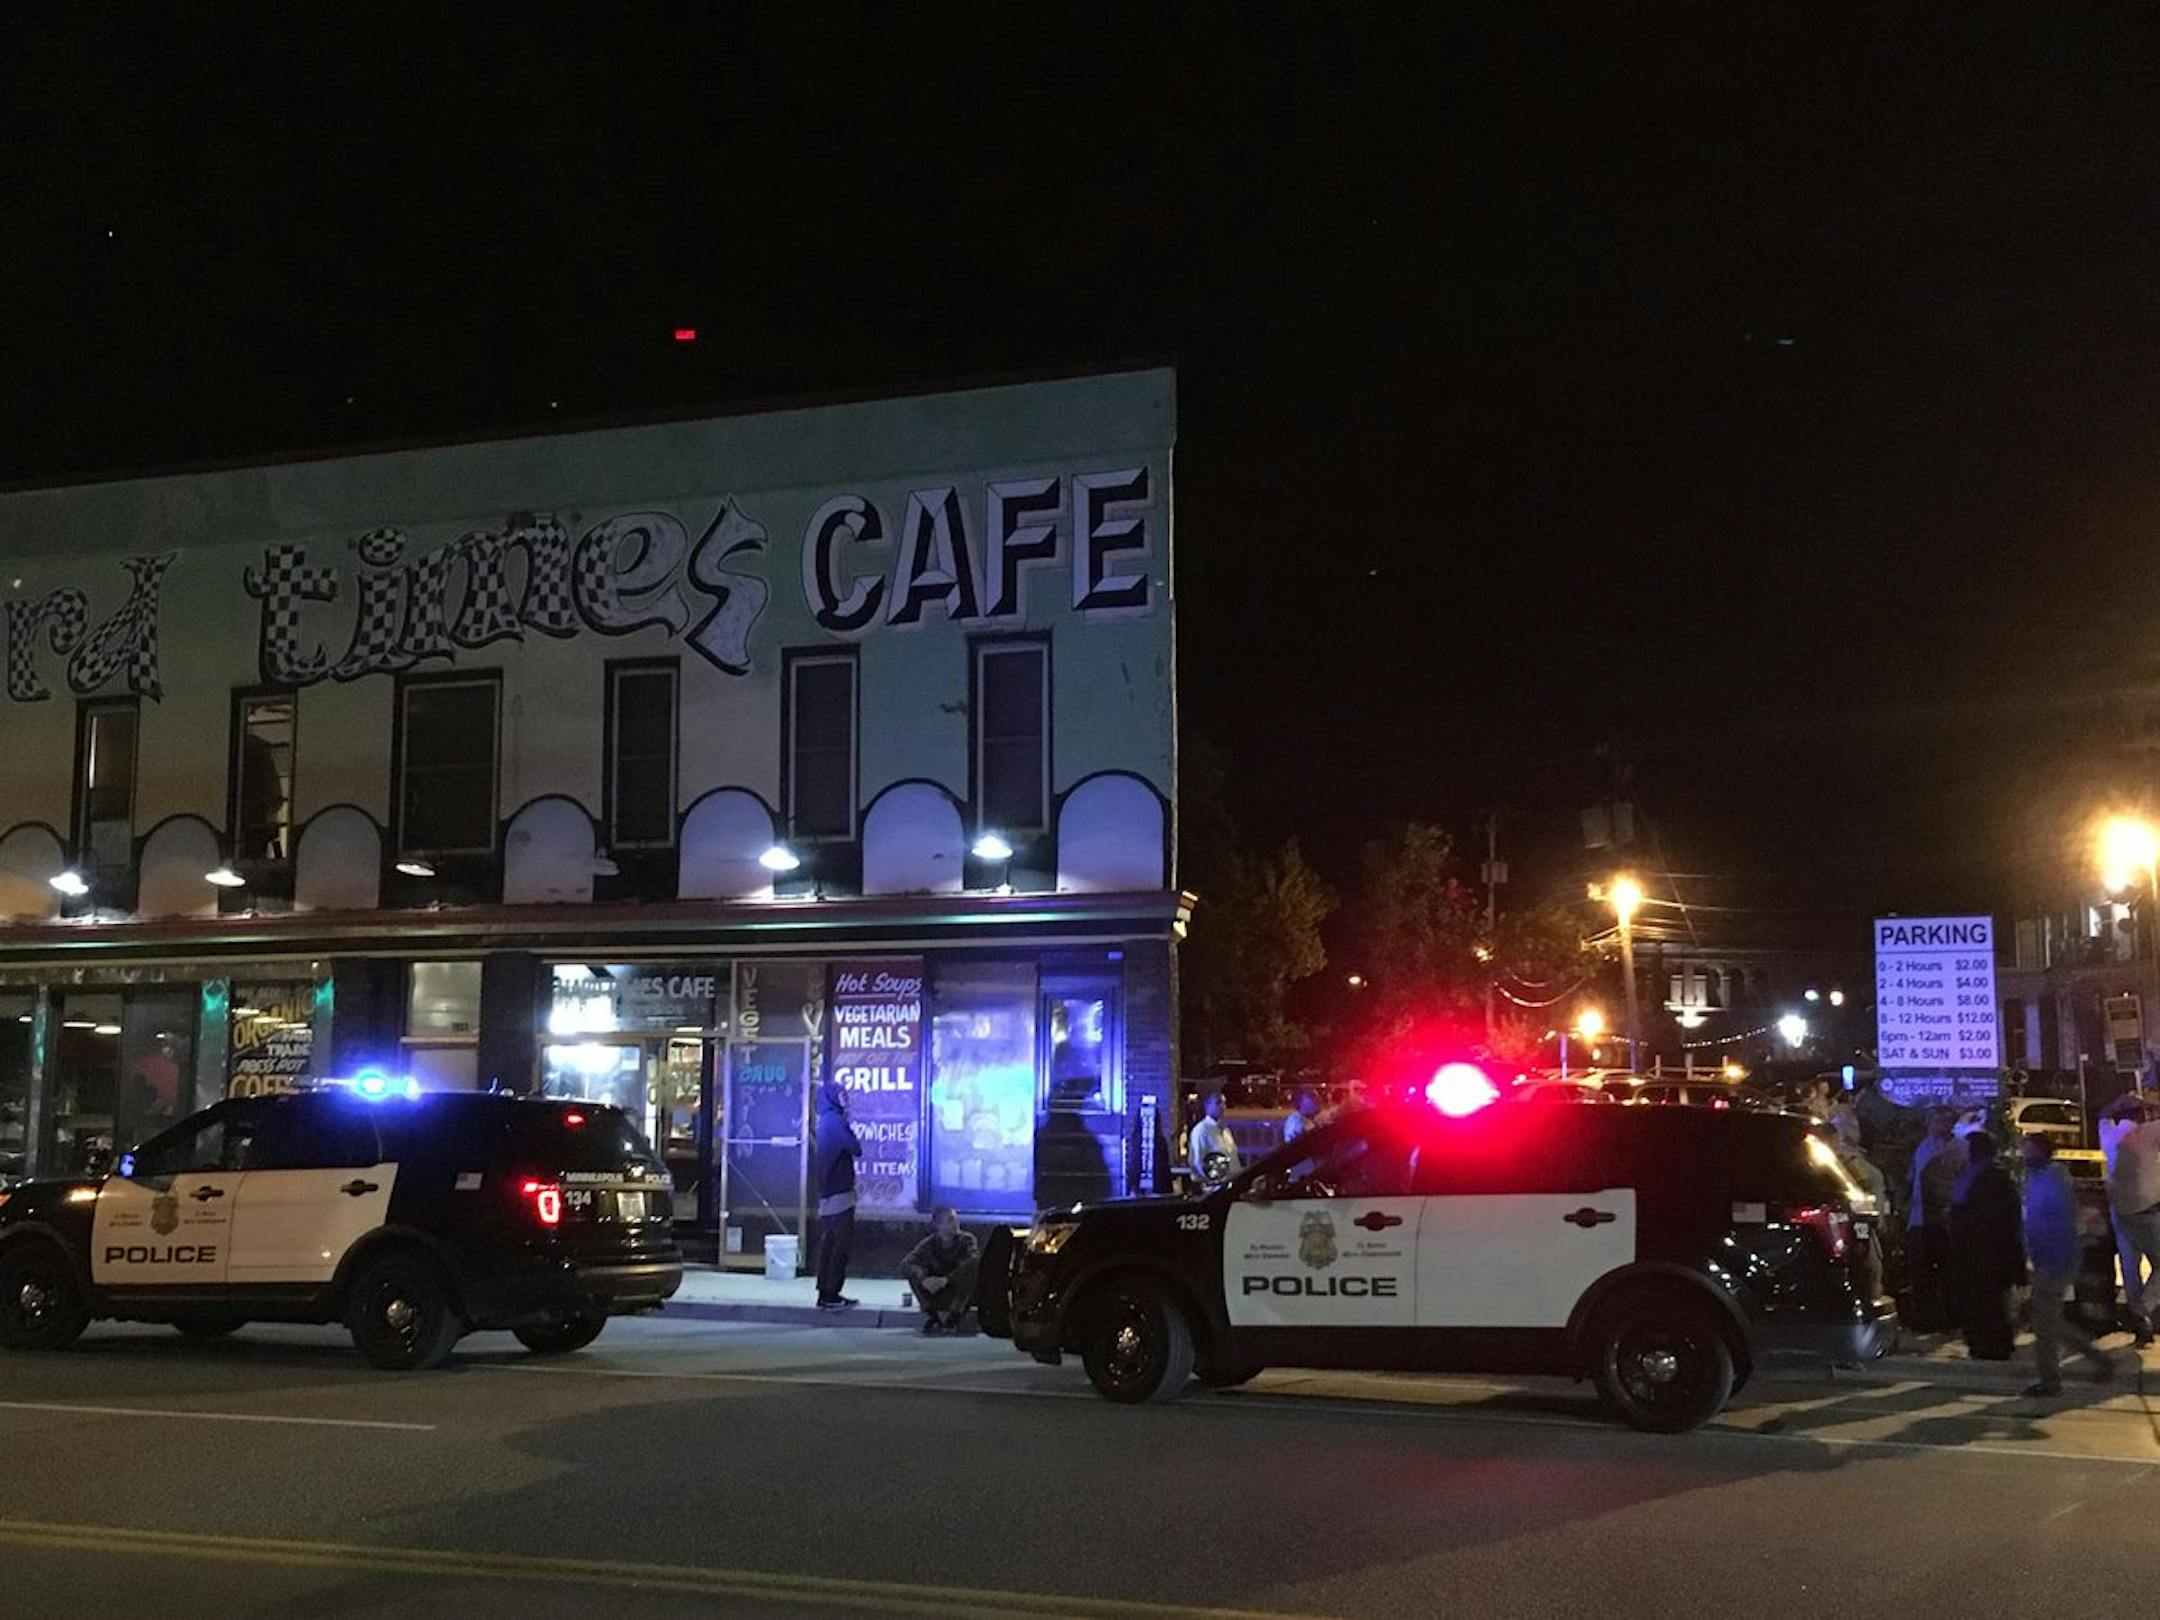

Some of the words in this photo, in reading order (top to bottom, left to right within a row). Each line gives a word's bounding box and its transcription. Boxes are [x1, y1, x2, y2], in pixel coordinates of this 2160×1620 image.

[243, 494, 768, 686] times
[802, 467, 1148, 634] CAFE
[1880, 923, 1986, 945] PARKING
[1896, 961, 1903, 971] 2
[1906, 961, 1942, 971] Hours
[1956, 959, 1987, 970] $2.00
[668, 977, 714, 998] CAFE
[836, 973, 868, 993] Hot
[872, 972, 922, 1000] Soups
[1880, 979, 1887, 988] 2
[1897, 979, 1903, 988] 4
[1907, 979, 1943, 988] Hours
[1956, 977, 1988, 988] $4.00
[1880, 996, 1887, 1005] 4
[1908, 995, 1943, 1005] Hours
[1957, 994, 1989, 1005] $8.00
[834, 1001, 921, 1025] VEGETARIAN
[1900, 1013, 1912, 1023] 12
[1915, 1013, 1951, 1023] Hours
[1958, 1012, 1993, 1023] $12.00
[840, 1026, 911, 1049] MEALS
[1919, 1030, 1951, 1040] 12am
[1959, 1030, 1991, 1041] $2.00
[267, 1043, 310, 1057] TRADE
[1881, 1048, 1905, 1058] SAT
[1909, 1048, 1918, 1058] &
[1922, 1048, 1950, 1058] SUN
[1960, 1048, 1992, 1058] $3.00
[835, 1066, 913, 1093] GRILL
[850, 1121, 913, 1141] NDWICHES
[873, 1162, 916, 1177] ITEMS
[565, 1190, 591, 1206] 134
[1177, 1214, 1210, 1230] 132
[105, 1246, 216, 1264] POLICE
[1243, 1277, 1397, 1296] POLICE
